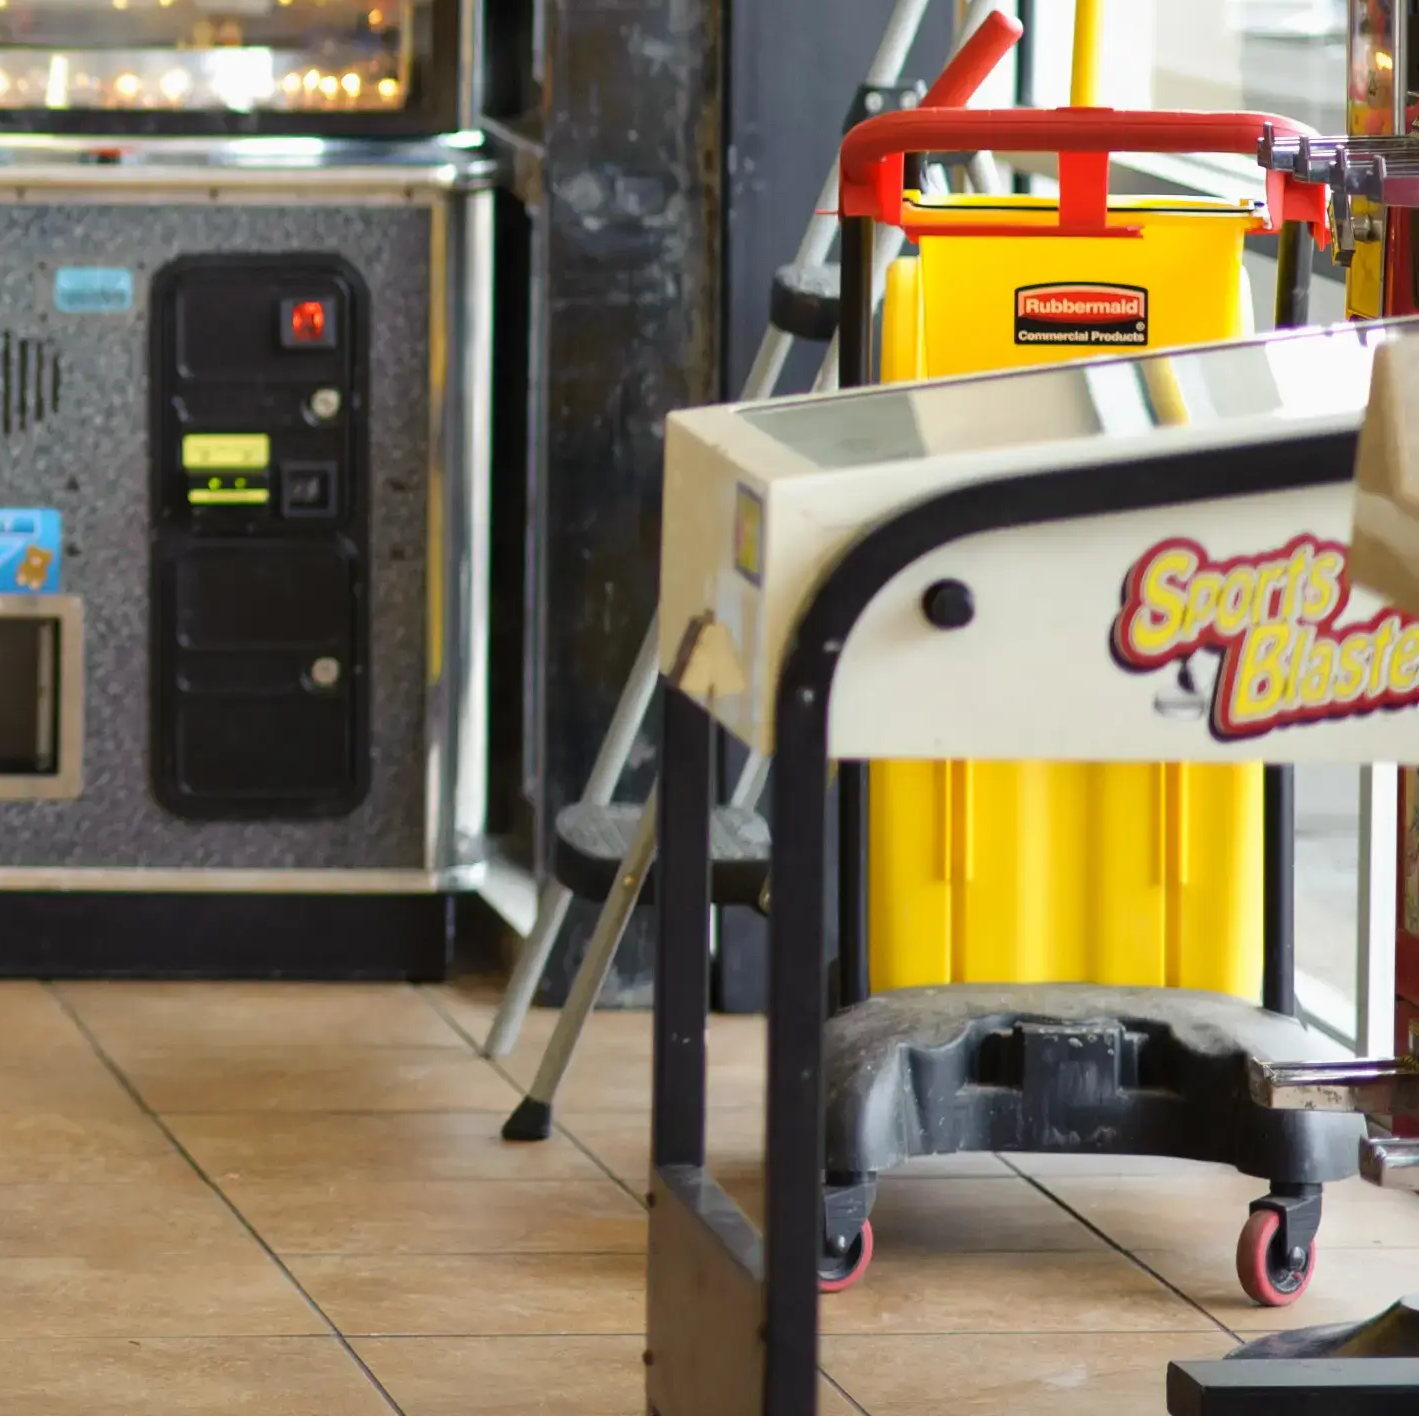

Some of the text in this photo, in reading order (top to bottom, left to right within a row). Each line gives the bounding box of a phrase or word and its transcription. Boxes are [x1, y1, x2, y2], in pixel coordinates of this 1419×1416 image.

[1025, 298, 1139, 315] Rubbermaid
[1018, 330, 1145, 343] Commercial Products
[1129, 544, 1345, 656] Sports
